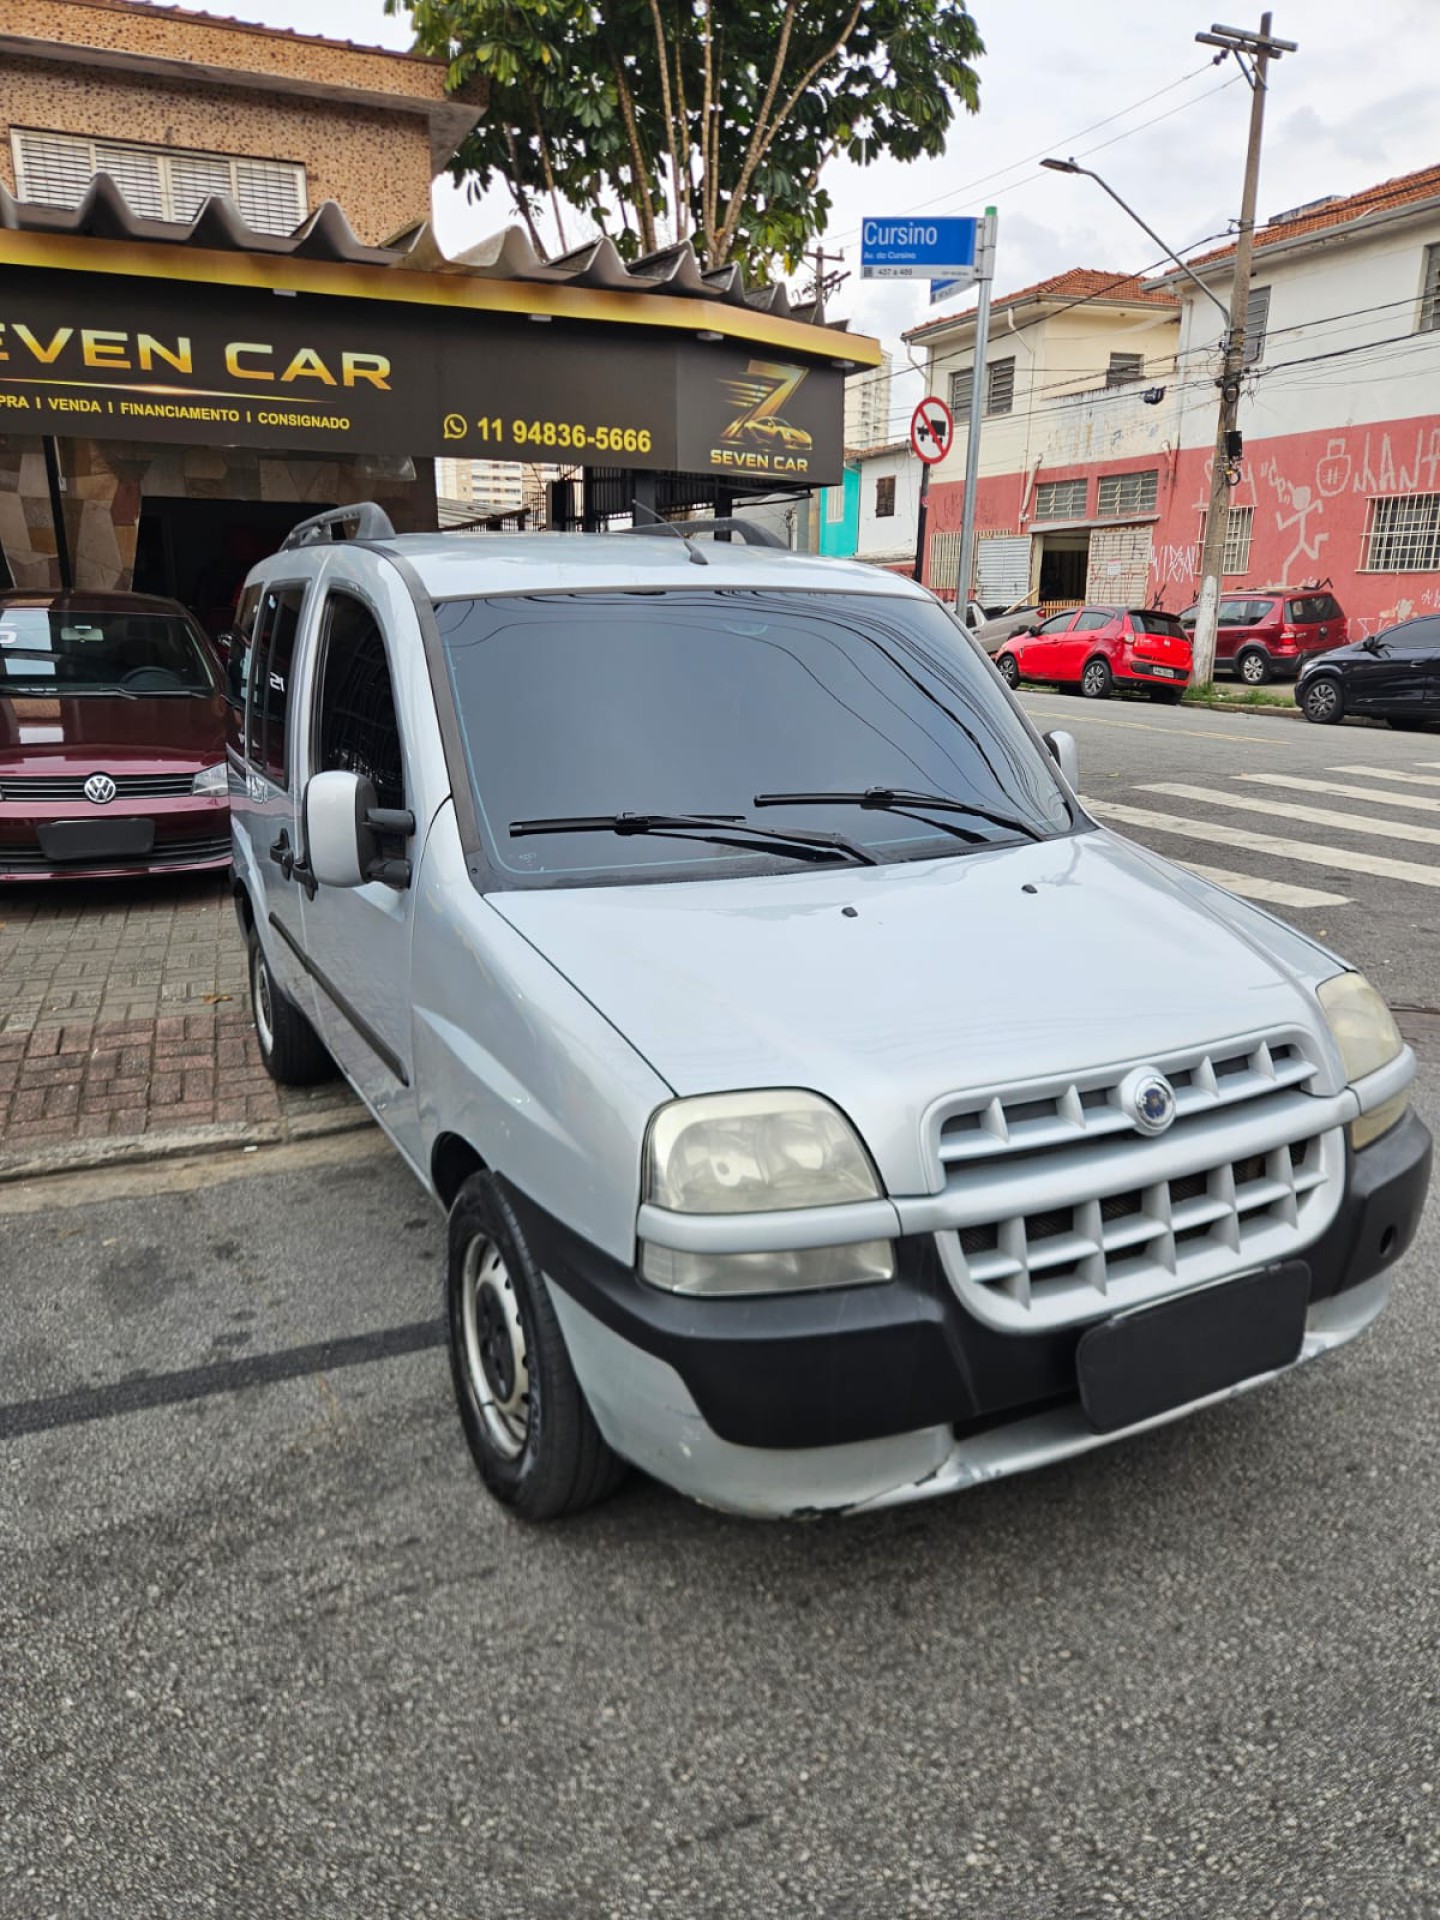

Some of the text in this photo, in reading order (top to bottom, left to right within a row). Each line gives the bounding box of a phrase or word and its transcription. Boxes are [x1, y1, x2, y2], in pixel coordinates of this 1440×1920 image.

[864, 221, 938, 246] Cursino
[0, 323, 392, 390] VEN CAR
[48, 398, 101, 413] VENDA
[121, 402, 239, 422] FINANCIAMENTO
[258, 412, 350, 430] CONSIGNADO
[478, 417, 651, 453] 11 94836-5666
[711, 449, 808, 472] SEVEN CAR
